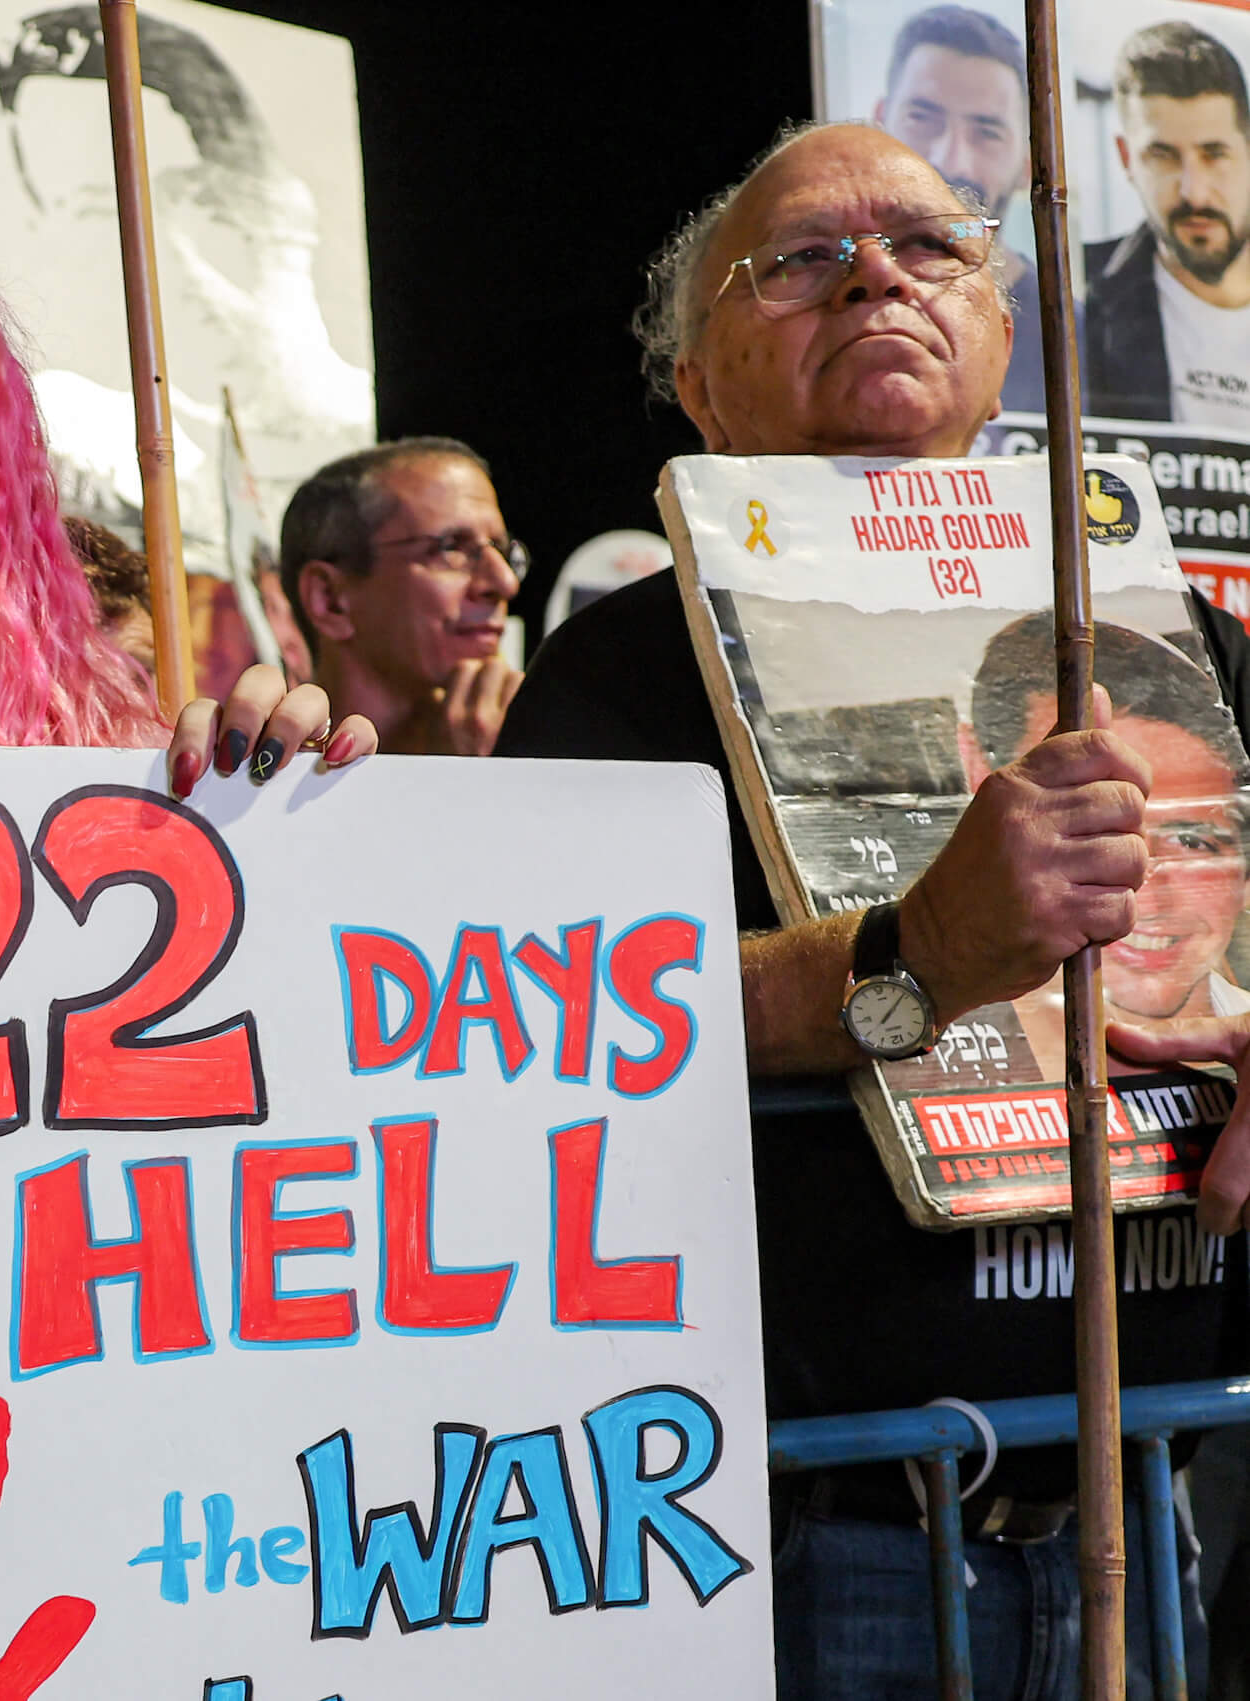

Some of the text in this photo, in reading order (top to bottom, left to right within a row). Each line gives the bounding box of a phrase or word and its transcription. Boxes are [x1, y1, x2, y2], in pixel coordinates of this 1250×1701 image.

[864, 469, 993, 512] הדר גולדין
[851, 512, 1030, 552] HADAR GOLDIN
[928, 556, 982, 599] (32)
[330, 912, 706, 1101] DAYS
[924, 1098, 1070, 1148] ההפקרה
[9, 1112, 690, 1382] HELL
[975, 1216, 1226, 1300] HOM NOW!
[128, 1385, 755, 1642] the WAR
